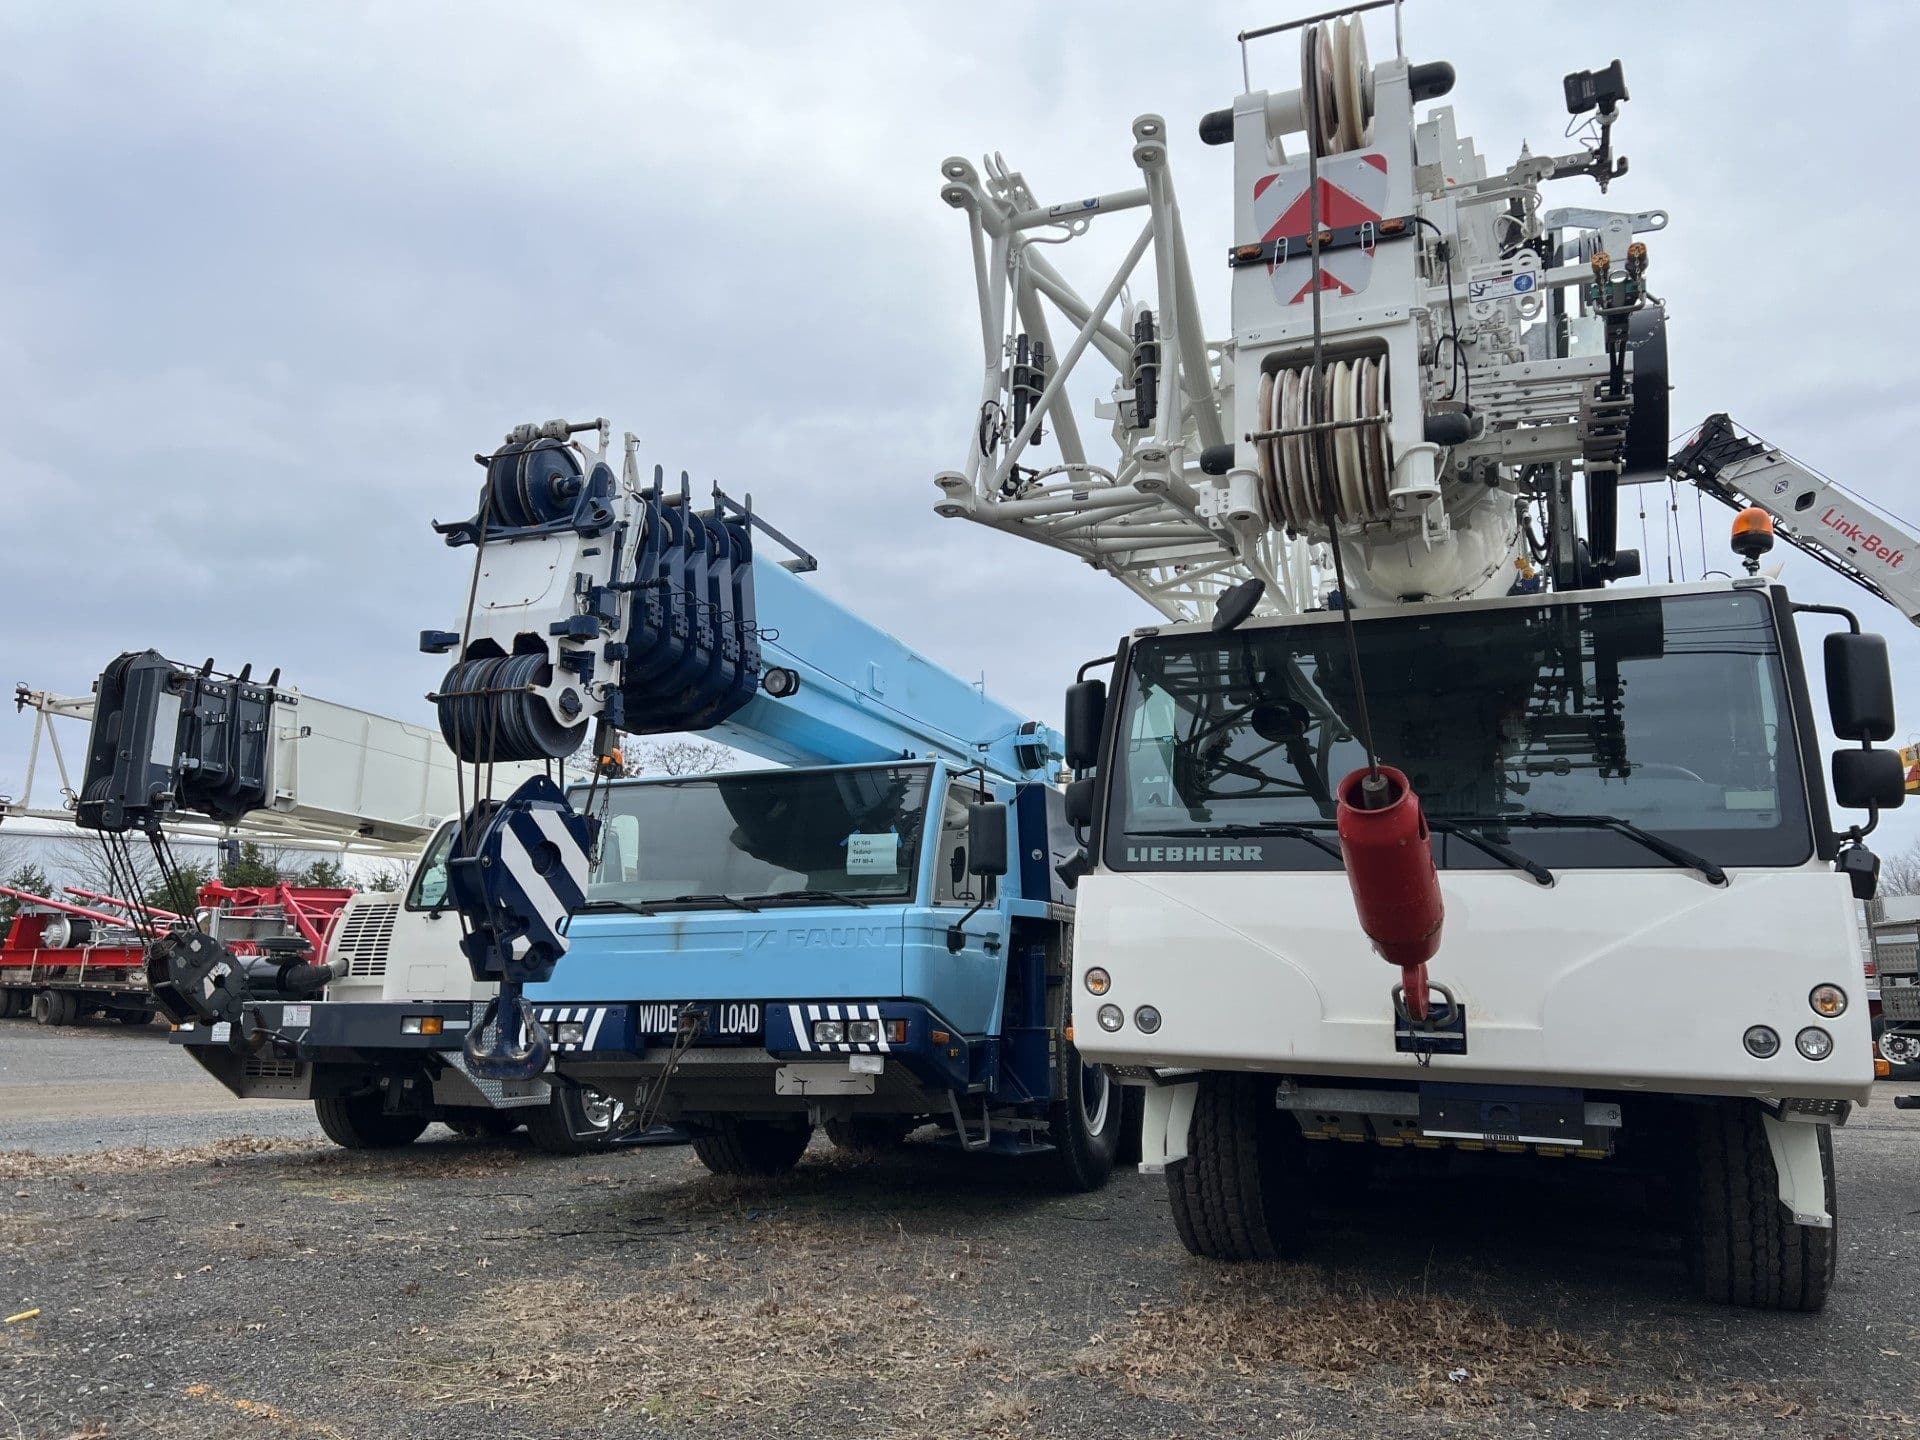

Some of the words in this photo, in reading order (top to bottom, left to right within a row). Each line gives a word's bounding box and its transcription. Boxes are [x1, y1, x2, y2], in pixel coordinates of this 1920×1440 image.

[1820, 507, 1904, 568] Link-Belt
[1126, 846, 1263, 862] LIEBHERR
[787, 928, 882, 949] FAUN
[640, 1004, 679, 1033] WIDE
[719, 1004, 760, 1034] LOAD
